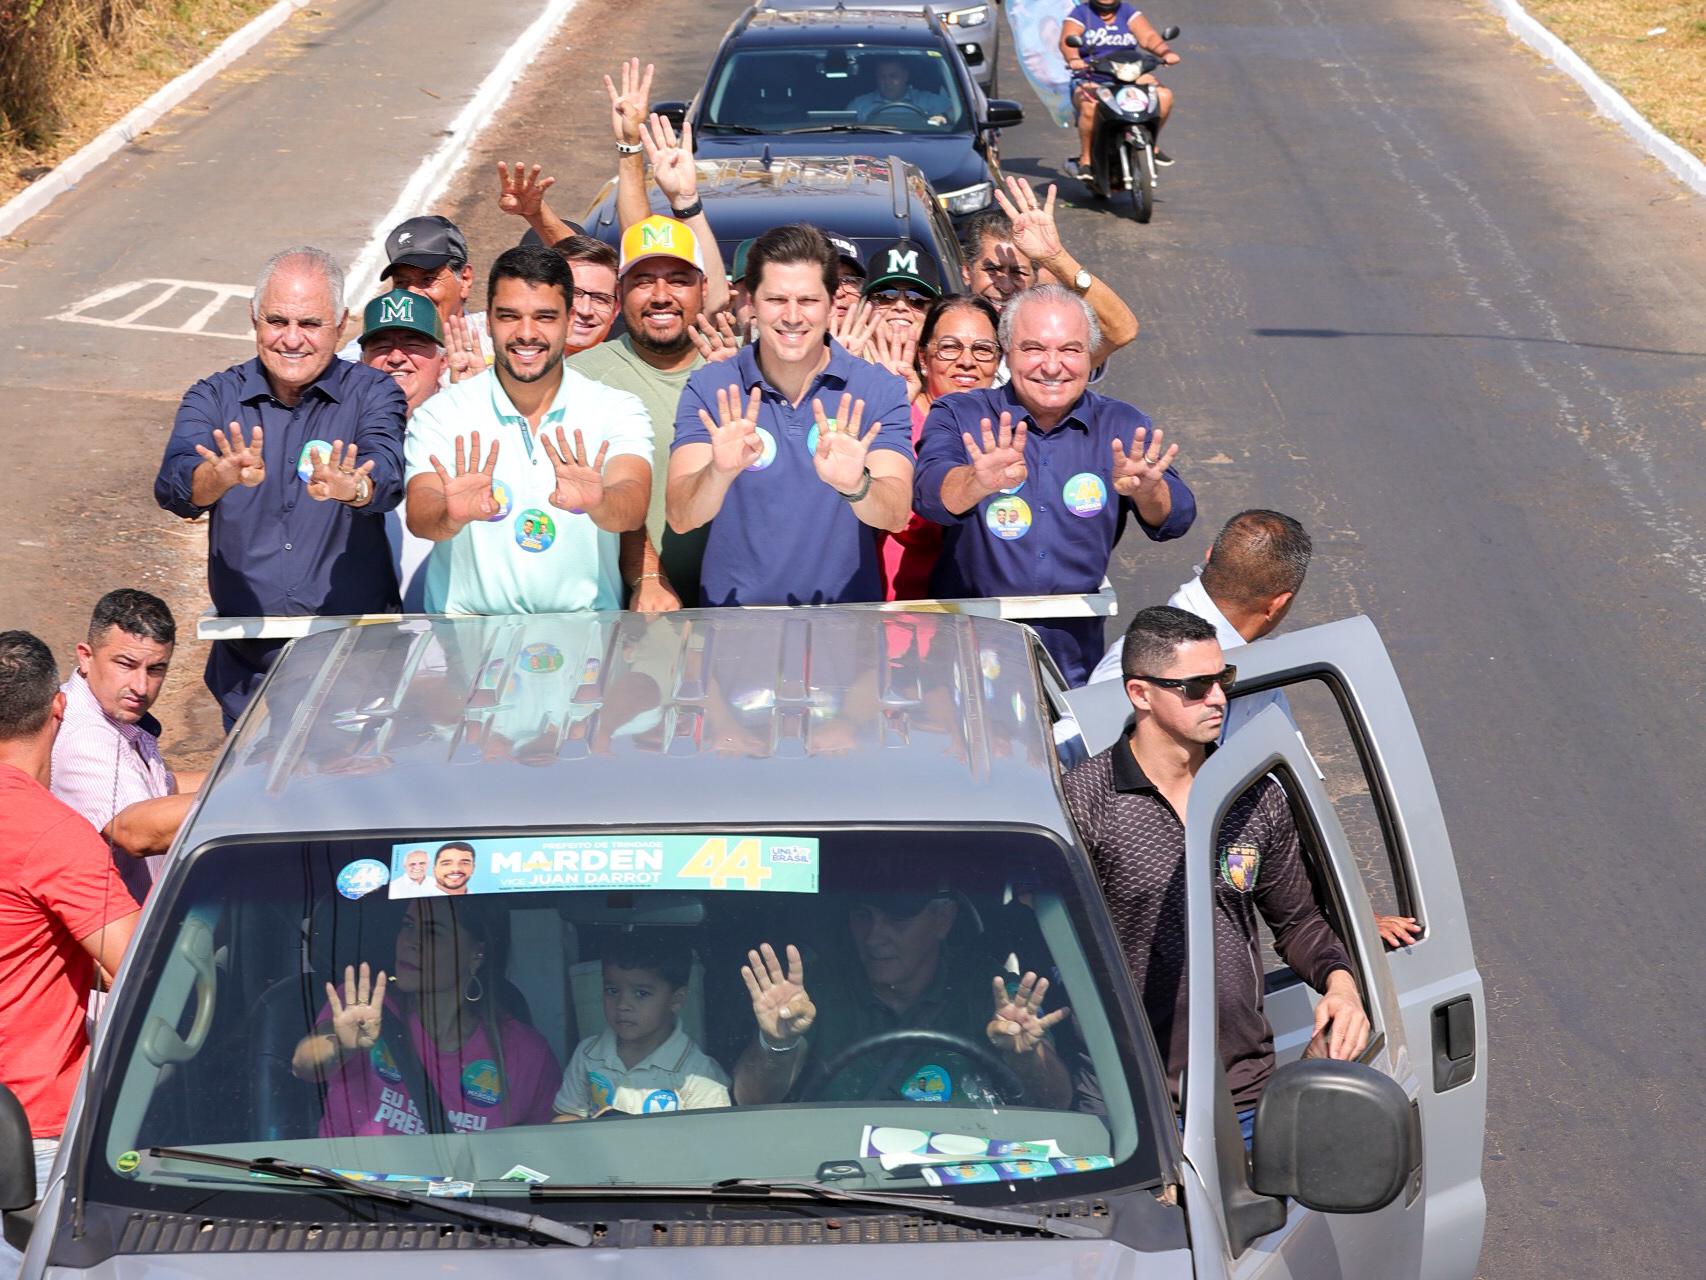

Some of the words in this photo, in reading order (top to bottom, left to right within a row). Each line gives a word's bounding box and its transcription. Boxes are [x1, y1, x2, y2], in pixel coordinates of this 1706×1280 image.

[640, 223, 674, 250] M
[886, 249, 919, 275] M
[380, 296, 414, 322] M
[542, 841, 593, 849] PREFEITO
[491, 849, 663, 873] MARDEN
[677, 837, 772, 889] 44
[772, 854, 809, 862] BRASIL
[500, 878, 527, 886] VICE
[530, 872, 578, 885] JUAN
[584, 872, 662, 883] DARROT
[379, 1087, 404, 1109] EU
